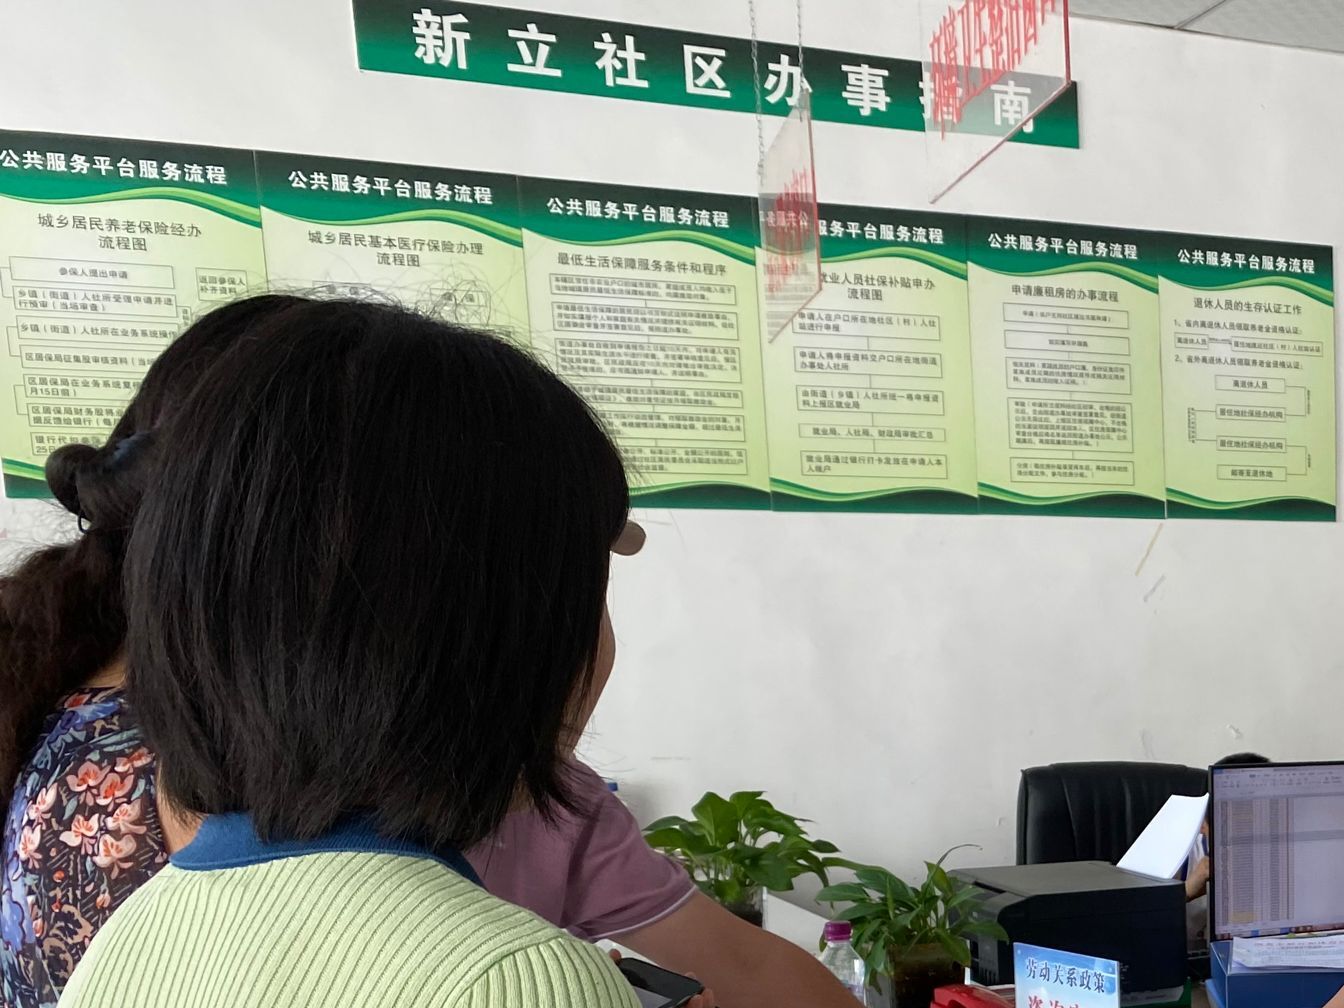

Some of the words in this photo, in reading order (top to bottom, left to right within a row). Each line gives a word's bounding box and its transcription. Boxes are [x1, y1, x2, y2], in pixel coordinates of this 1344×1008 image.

[0, 150, 228, 185] 公共服务平台服务流程
[288, 170, 493, 205] 公共服务平台服务流程
[546, 198, 730, 228] 公共服务平台服务流程
[37, 214, 202, 238] 城乡居民养老保险经办
[98, 235, 147, 251] 流程图
[308, 230, 484, 256] 城乡居民基本医疗保险办理
[988, 232, 1138, 259] 公共服务平台服务流程
[377, 252, 420, 267] 流程图
[557, 252, 727, 276] 最低生活保障服务条件和程序
[1177, 248, 1315, 274] 公共服务平台服务流程
[848, 287, 883, 301] 流程图
[1011, 284, 1119, 303] 申请廉租房的办事流程
[1194, 297, 1302, 315] 退休人员的生存认证工作
[1026, 958, 1105, 993] 劳动关系政策
